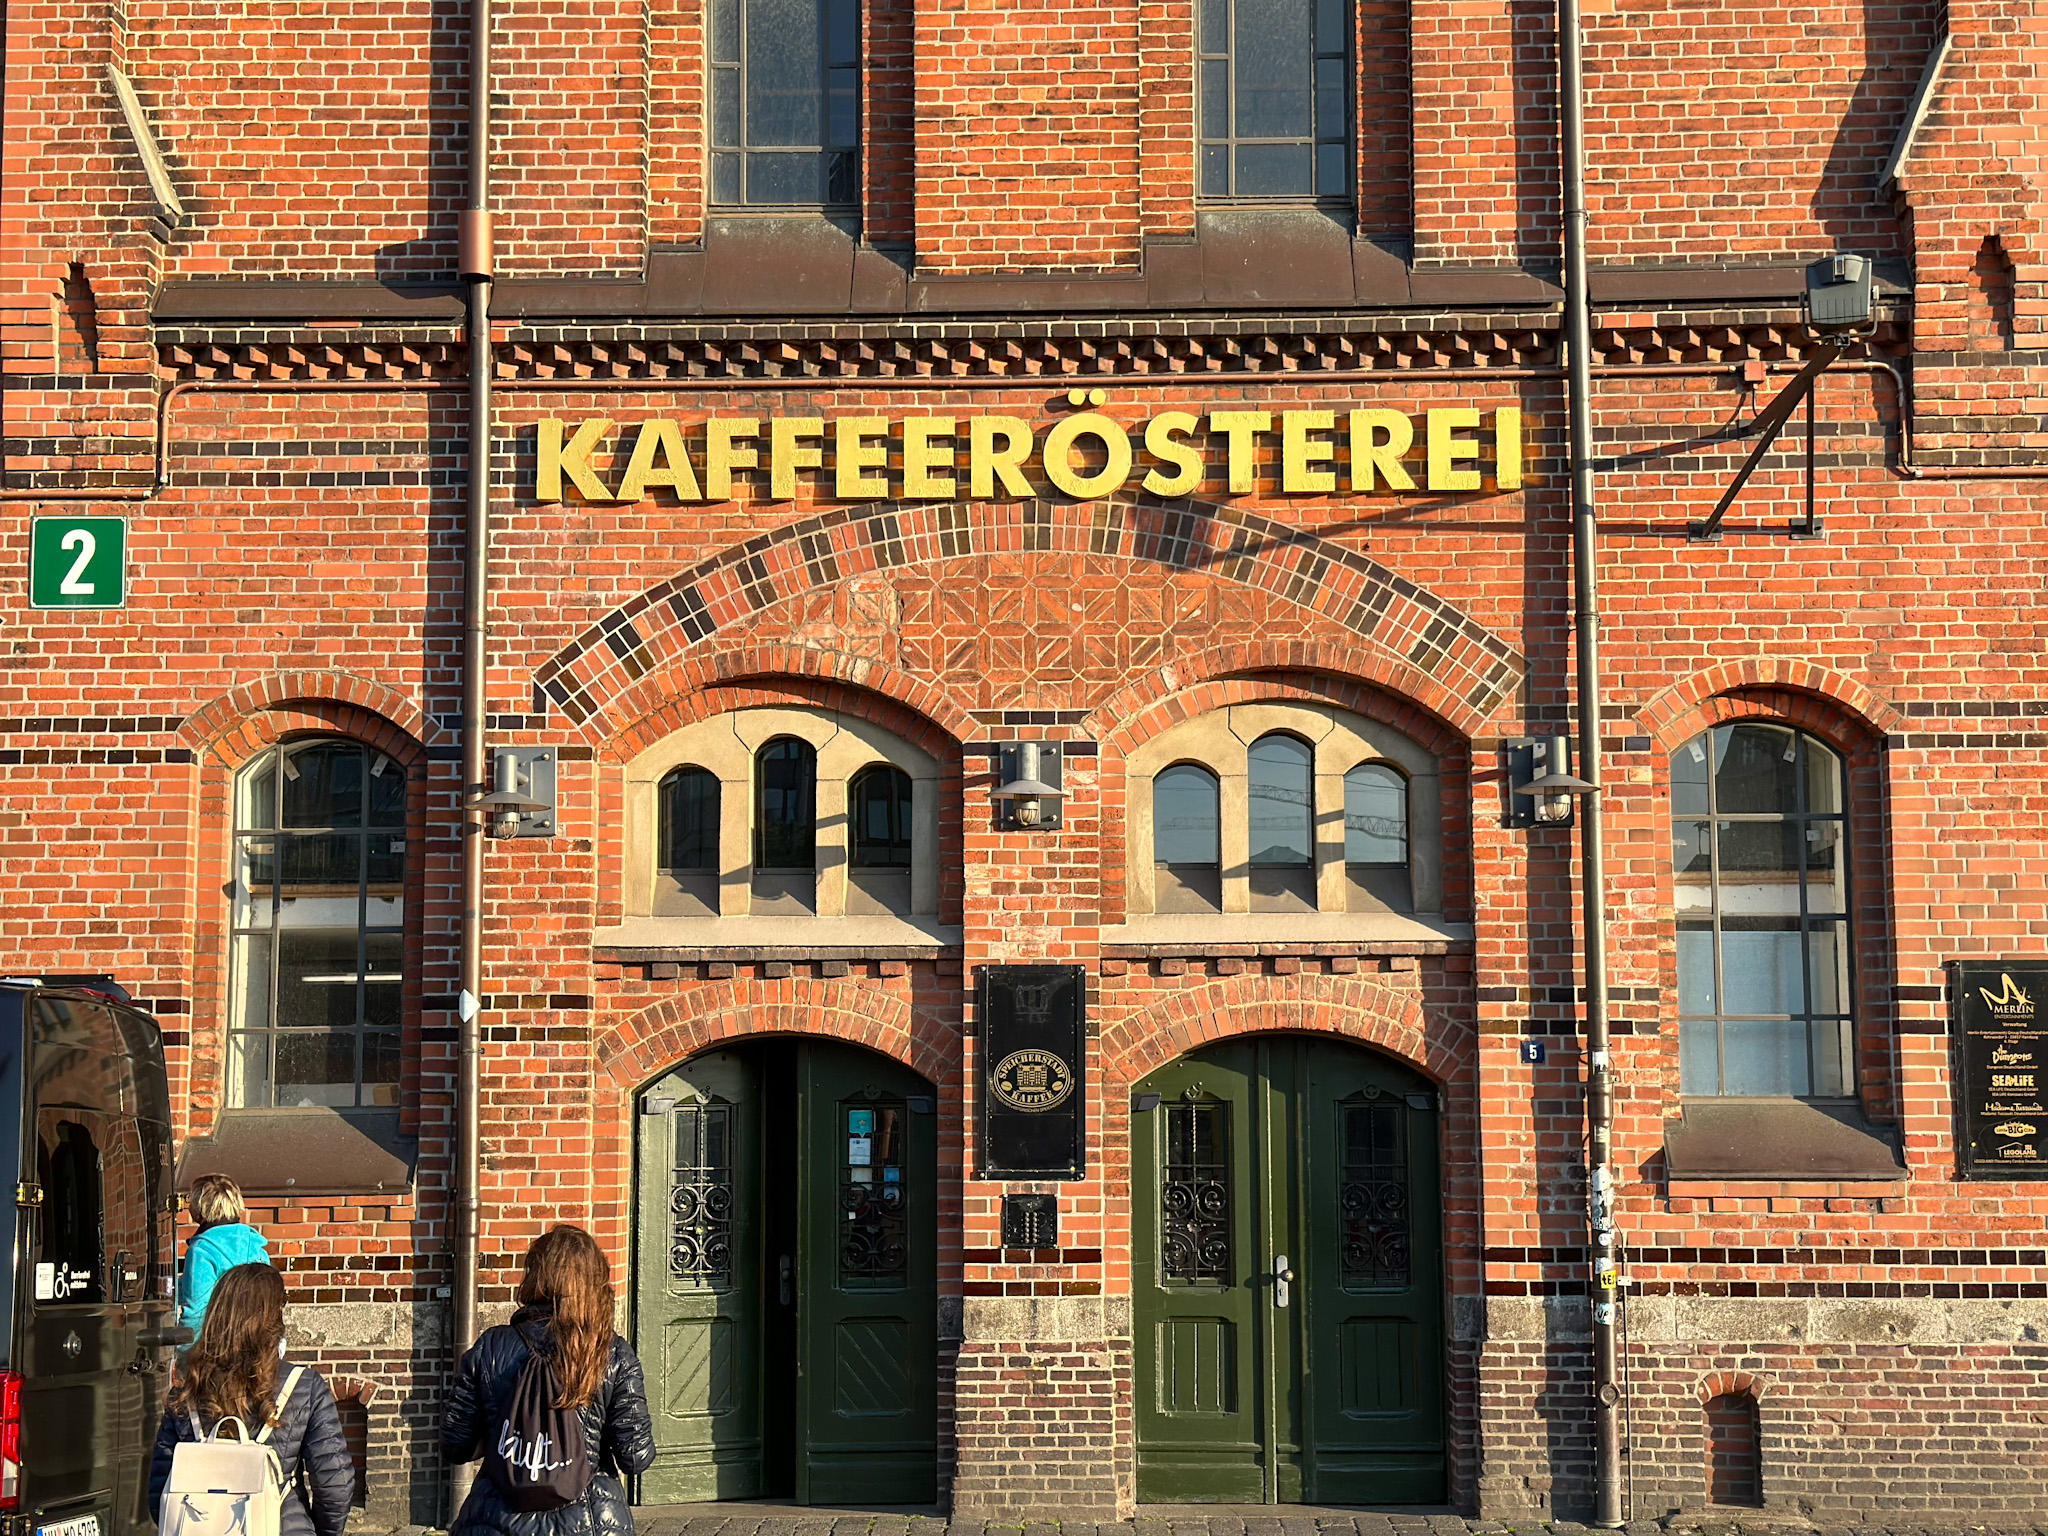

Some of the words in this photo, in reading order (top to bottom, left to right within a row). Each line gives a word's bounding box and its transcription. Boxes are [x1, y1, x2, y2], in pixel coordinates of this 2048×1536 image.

[537, 388, 1522, 501] KAFFEERÖSTEREI
[60, 528, 96, 595] 2
[1994, 1005, 2034, 1013] MERLIN
[1529, 1044, 1538, 1060] 5
[999, 1054, 1066, 1079] SPEICHERSTADT
[1011, 1091, 1054, 1103] KAFFEE
[1985, 1101, 2015, 1112] Madame
[2008, 1126, 2024, 1134] BIG
